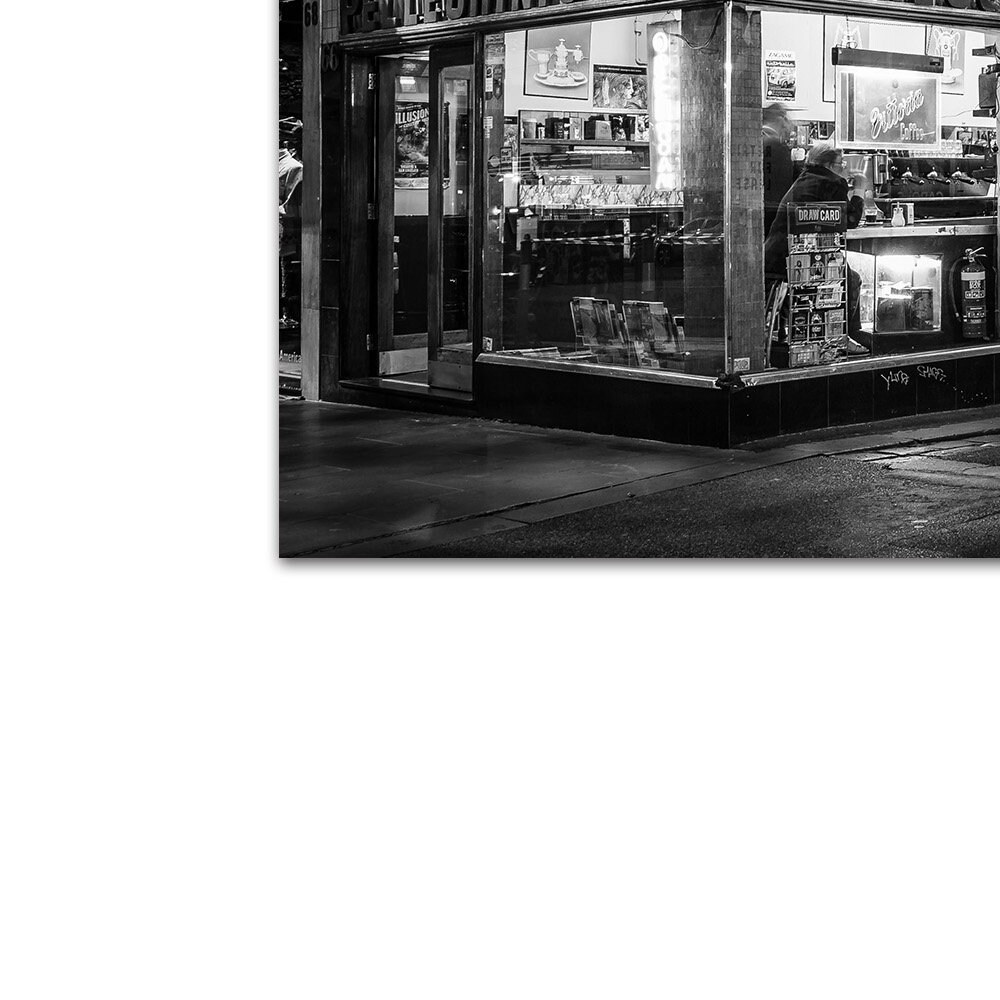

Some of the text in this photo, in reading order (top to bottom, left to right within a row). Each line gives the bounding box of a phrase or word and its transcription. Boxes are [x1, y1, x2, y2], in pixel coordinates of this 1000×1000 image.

[304, 1, 318, 27] 68
[322, 44, 338, 71] 66
[798, 209, 840, 221] DRAW CARD
